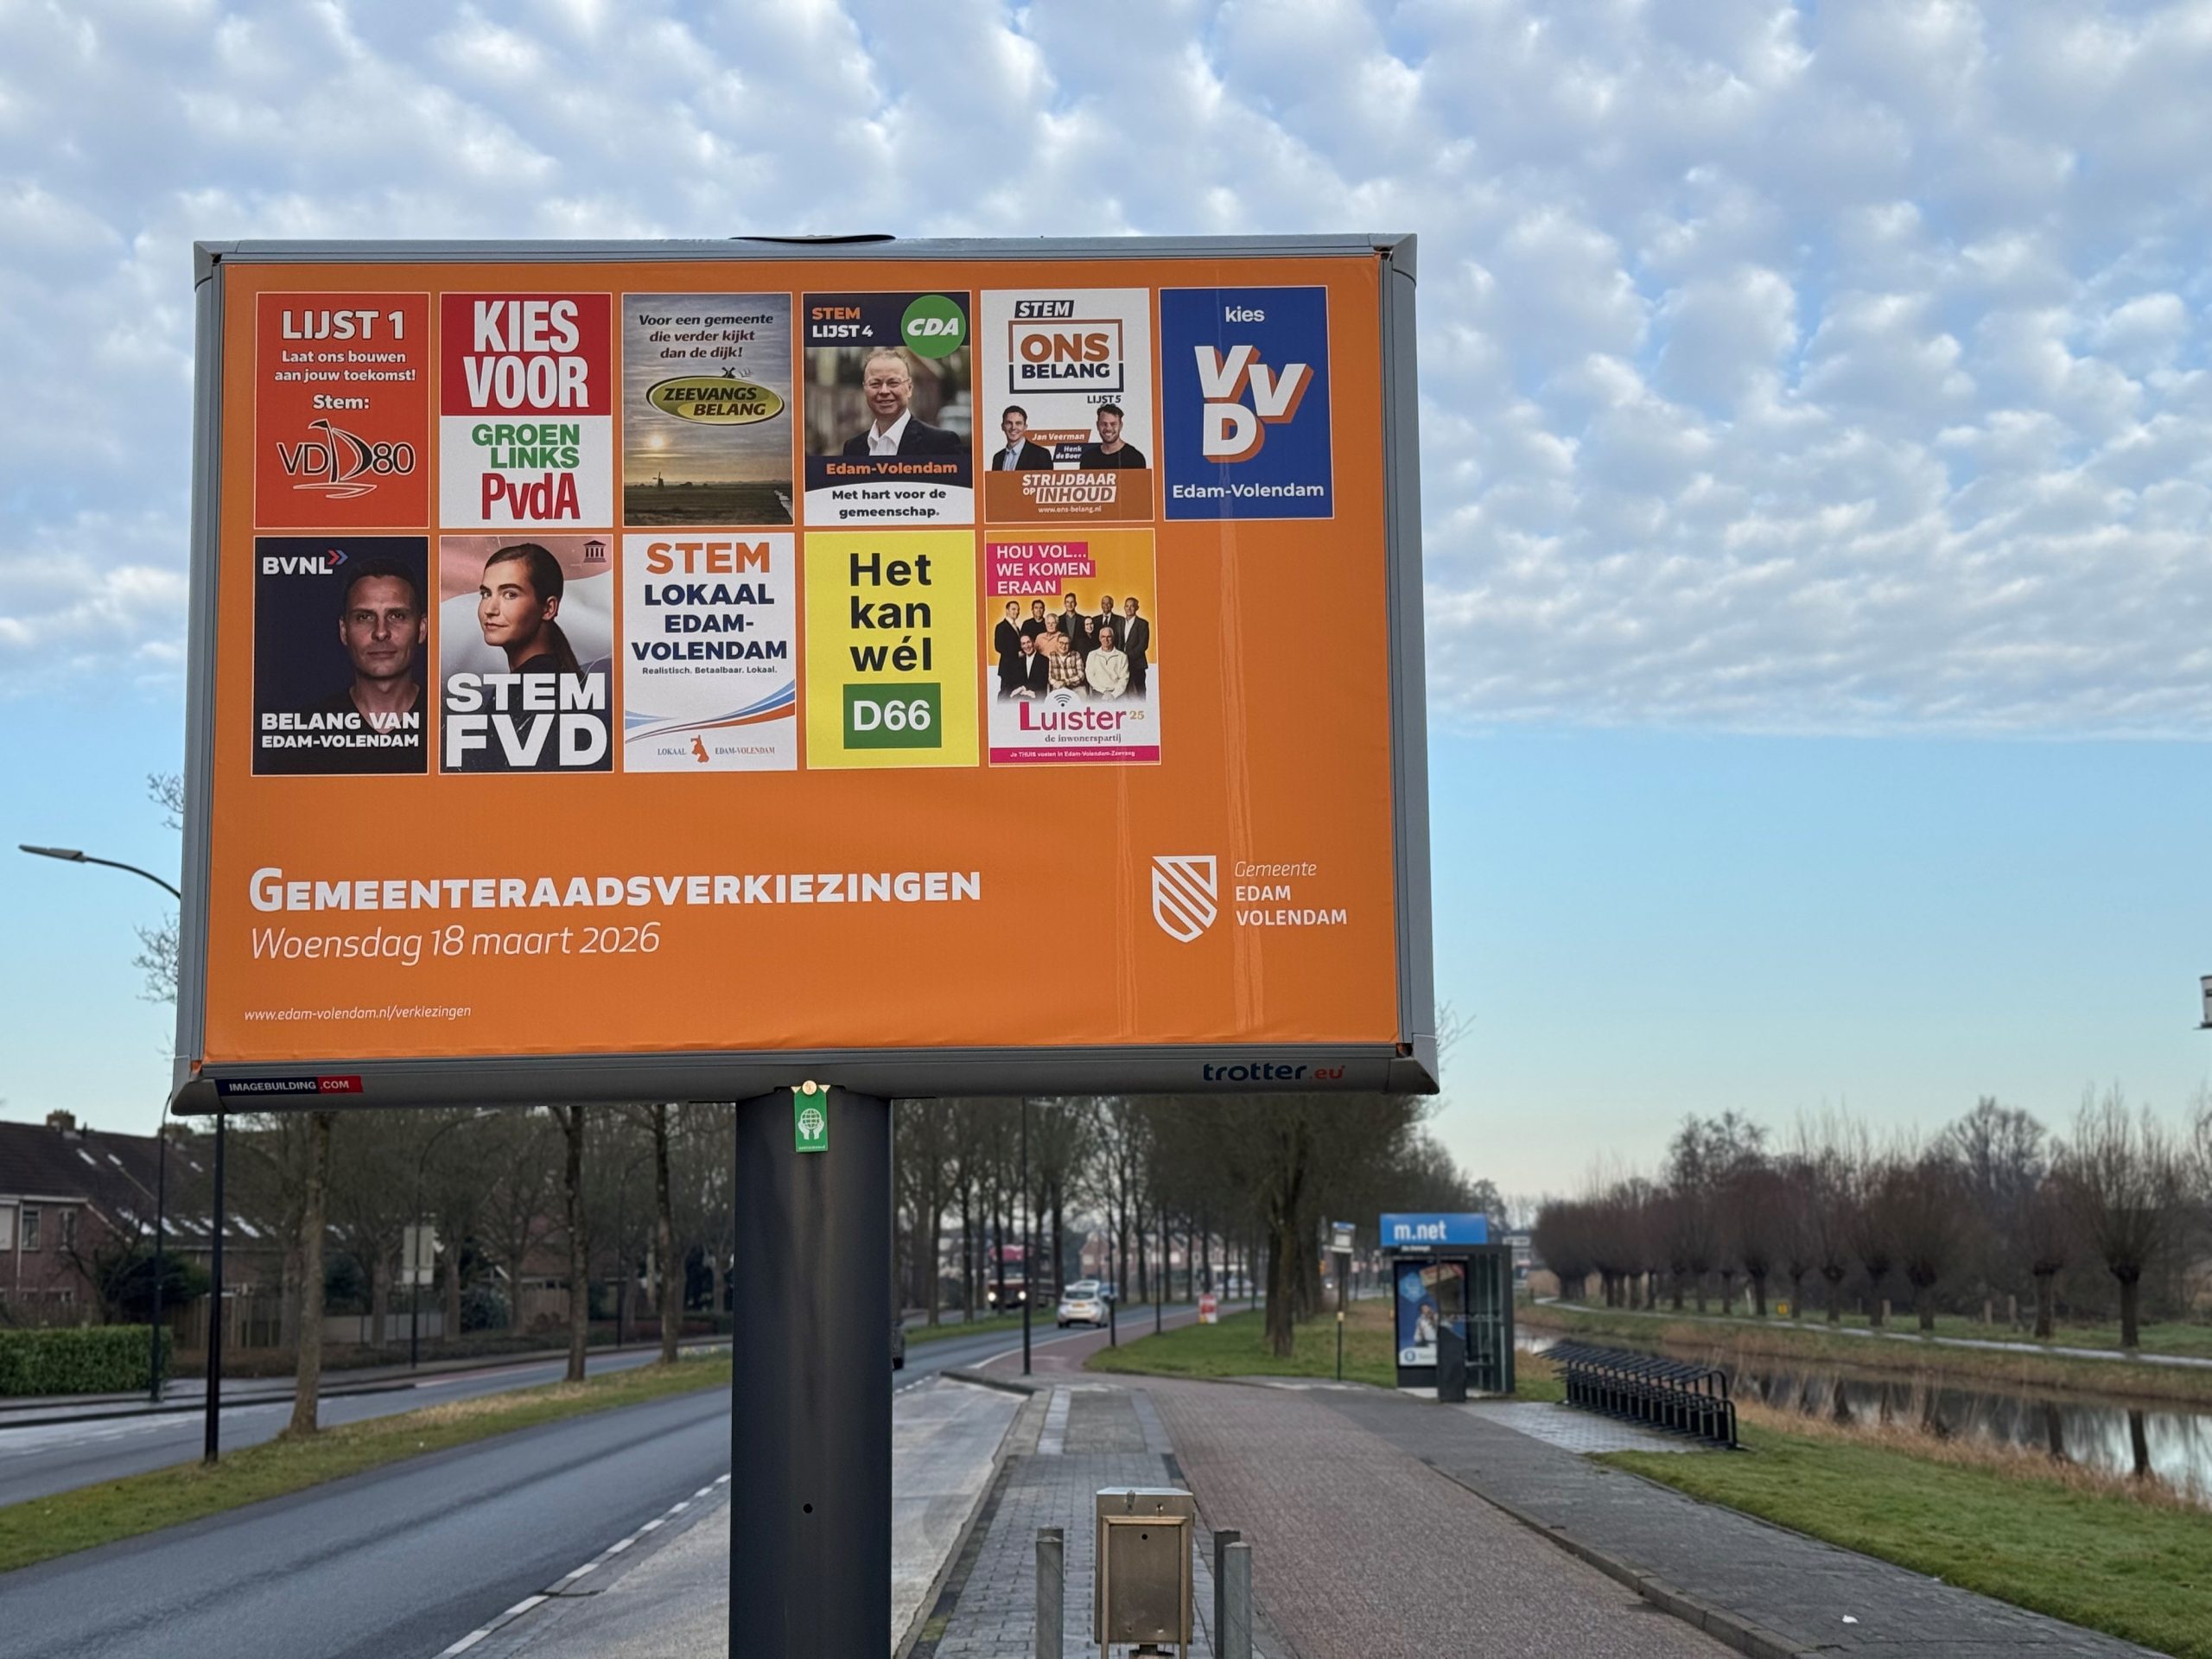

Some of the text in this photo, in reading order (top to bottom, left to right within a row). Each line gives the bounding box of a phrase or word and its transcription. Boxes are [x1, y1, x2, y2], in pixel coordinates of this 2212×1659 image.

[811, 307, 861, 321] STEM
[1018, 302, 1071, 318] STEM
[1225, 306, 1266, 322] kies
[282, 309, 405, 340] LIJST 1
[474, 300, 580, 353] KIES
[639, 314, 774, 327] Voor een gemeente
[906, 318, 960, 337] CDA
[649, 329, 756, 344] die verder kijkt
[812, 325, 874, 338] LIJST 4
[281, 349, 406, 364] Laat ons bouwen
[660, 346, 743, 360] dan de dijk!
[1020, 333, 1110, 363] ONS
[274, 368, 416, 384] aan jouw toekomst!
[1021, 363, 1111, 379] BELANG
[463, 355, 589, 409] VOOR
[312, 394, 371, 410] Stem:
[663, 387, 758, 401] ZEEVANGS
[1087, 395, 1122, 404] LIJST 5
[693, 403, 766, 416] BELANG
[1194, 345, 1314, 463] VVD
[471, 423, 581, 447] GROEN
[1032, 433, 1047, 442] Jan
[490, 446, 581, 469] LINKS
[826, 461, 958, 476] Edam-Volendam
[1022, 473, 1116, 486] STRIJDBAAR
[481, 473, 582, 520] PvdA
[832, 487, 947, 500] Met hart voor de
[1022, 487, 1114, 503] OP INHOUD
[1173, 482, 1325, 499] Edam-Volendam
[839, 505, 941, 519] gemeenschap.
[1038, 505, 1102, 514] www.ons-belang.nl
[646, 542, 771, 575] STEM
[996, 543, 1087, 560] HOU VOL...
[262, 556, 334, 575] BVNL
[849, 552, 932, 587] Het
[996, 562, 1091, 577] WE KOMEN
[645, 583, 775, 607] LOKAAL
[997, 581, 1057, 595] ERAAN
[850, 595, 931, 629] kan
[664, 613, 754, 633] EDAM-
[631, 640, 788, 661] VOLENDAM
[849, 635, 932, 672] wél
[642, 665, 778, 676] Realistisch. Betaalbaar. Lokaal.
[446, 672, 606, 713] STEM
[261, 711, 420, 731] BELANG VAN
[853, 699, 931, 732] D66
[1020, 702, 1145, 731] Luister 25
[261, 734, 419, 748] EDAM-VOLENDAM
[446, 713, 607, 767] FVD
[1045, 734, 1122, 744] de inwonerspartij
[657, 746, 775, 756] LOKAAL EDAM-VOLENDAM
[1235, 861, 1318, 878] Gemeente
[1235, 885, 1292, 902] EDAM
[1236, 908, 1348, 926] VOLENDAM
[251, 921, 662, 967] Woensdag 18 maart 2026
[244, 1004, 472, 1022] www.edam-volendam.nl/verkiezingen
